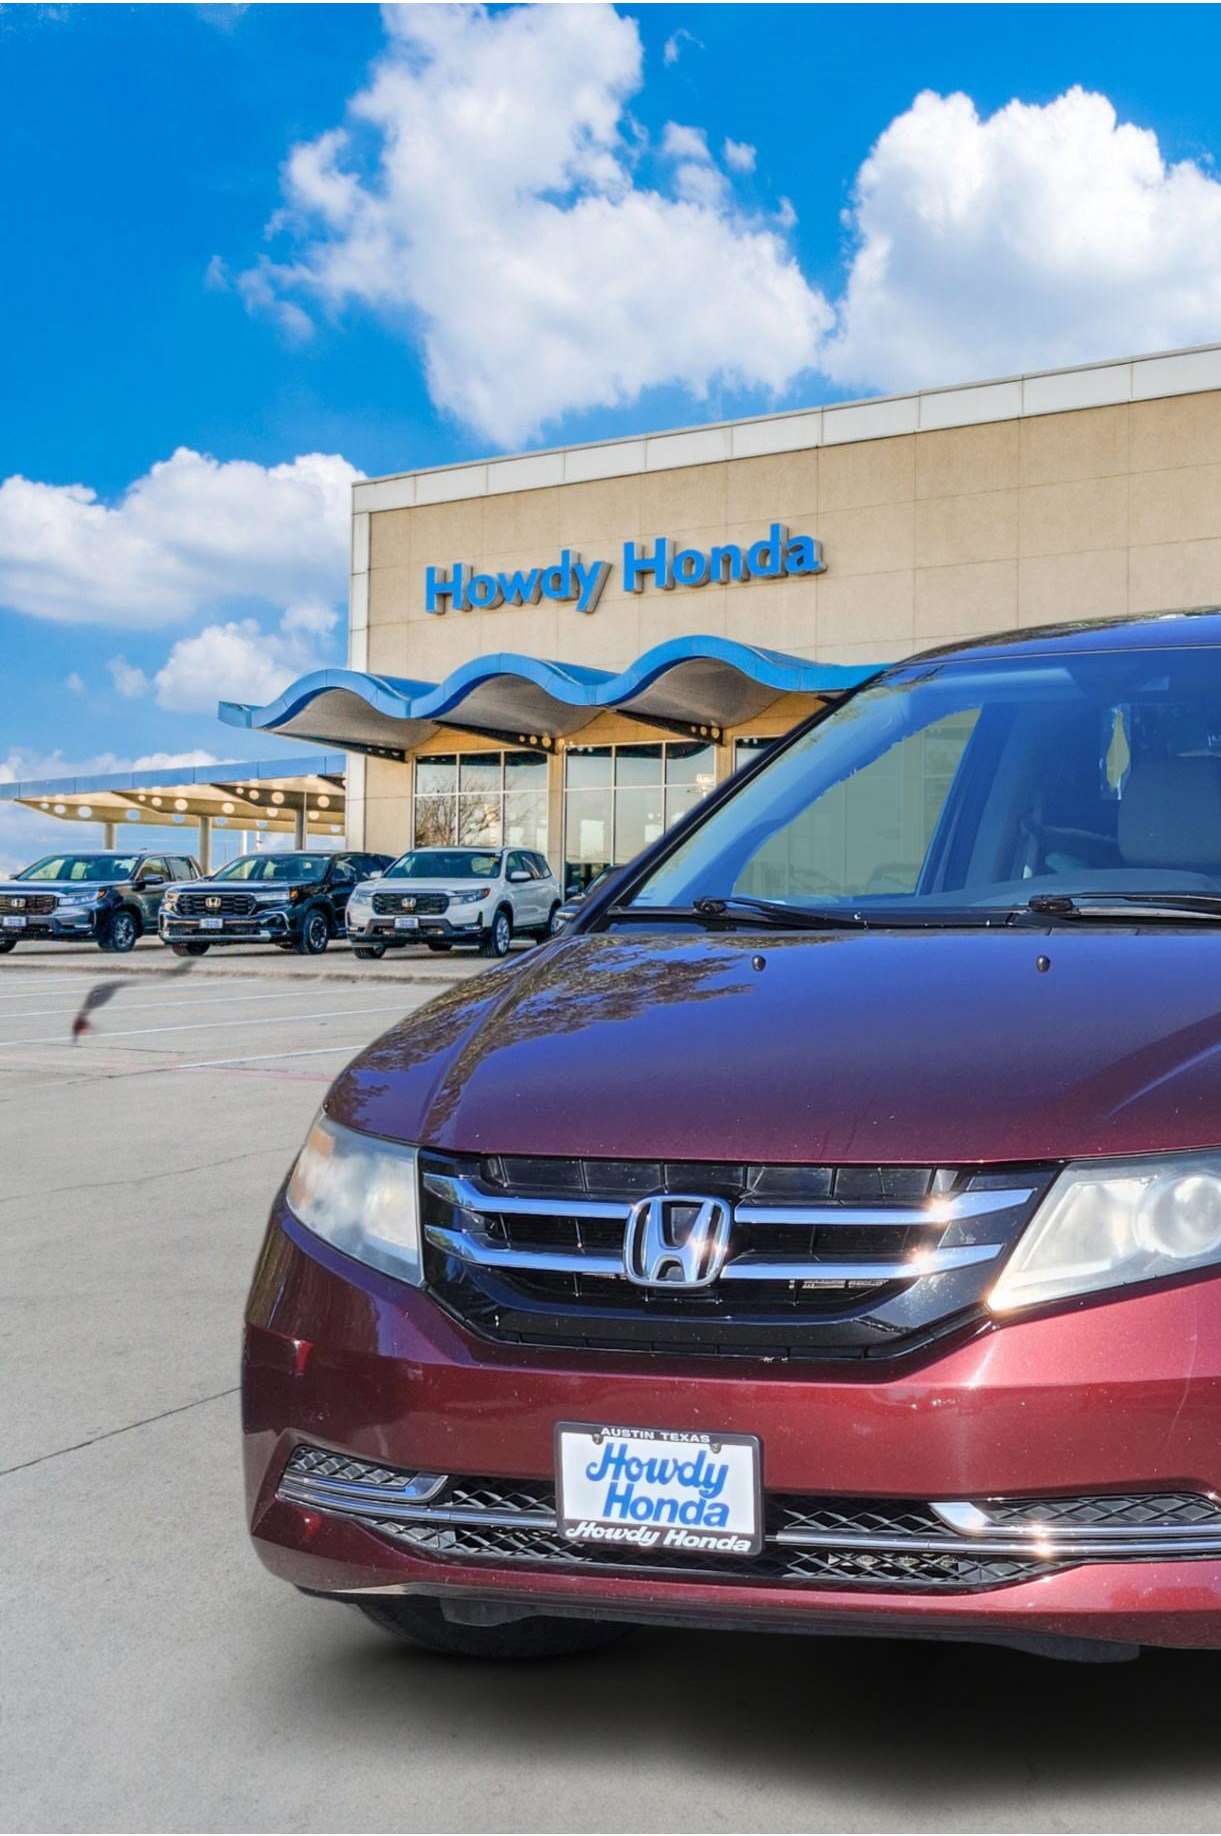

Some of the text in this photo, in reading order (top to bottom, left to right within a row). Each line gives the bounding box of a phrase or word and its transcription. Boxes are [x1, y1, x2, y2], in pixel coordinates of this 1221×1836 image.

[425, 523, 826, 614] Howdy Honda
[601, 1427, 711, 1444] AUSTIN TEXAS
[585, 1442, 729, 1499] Howdy
[602, 1480, 730, 1528] Honda
[565, 1521, 752, 1552] Howdy Honda
